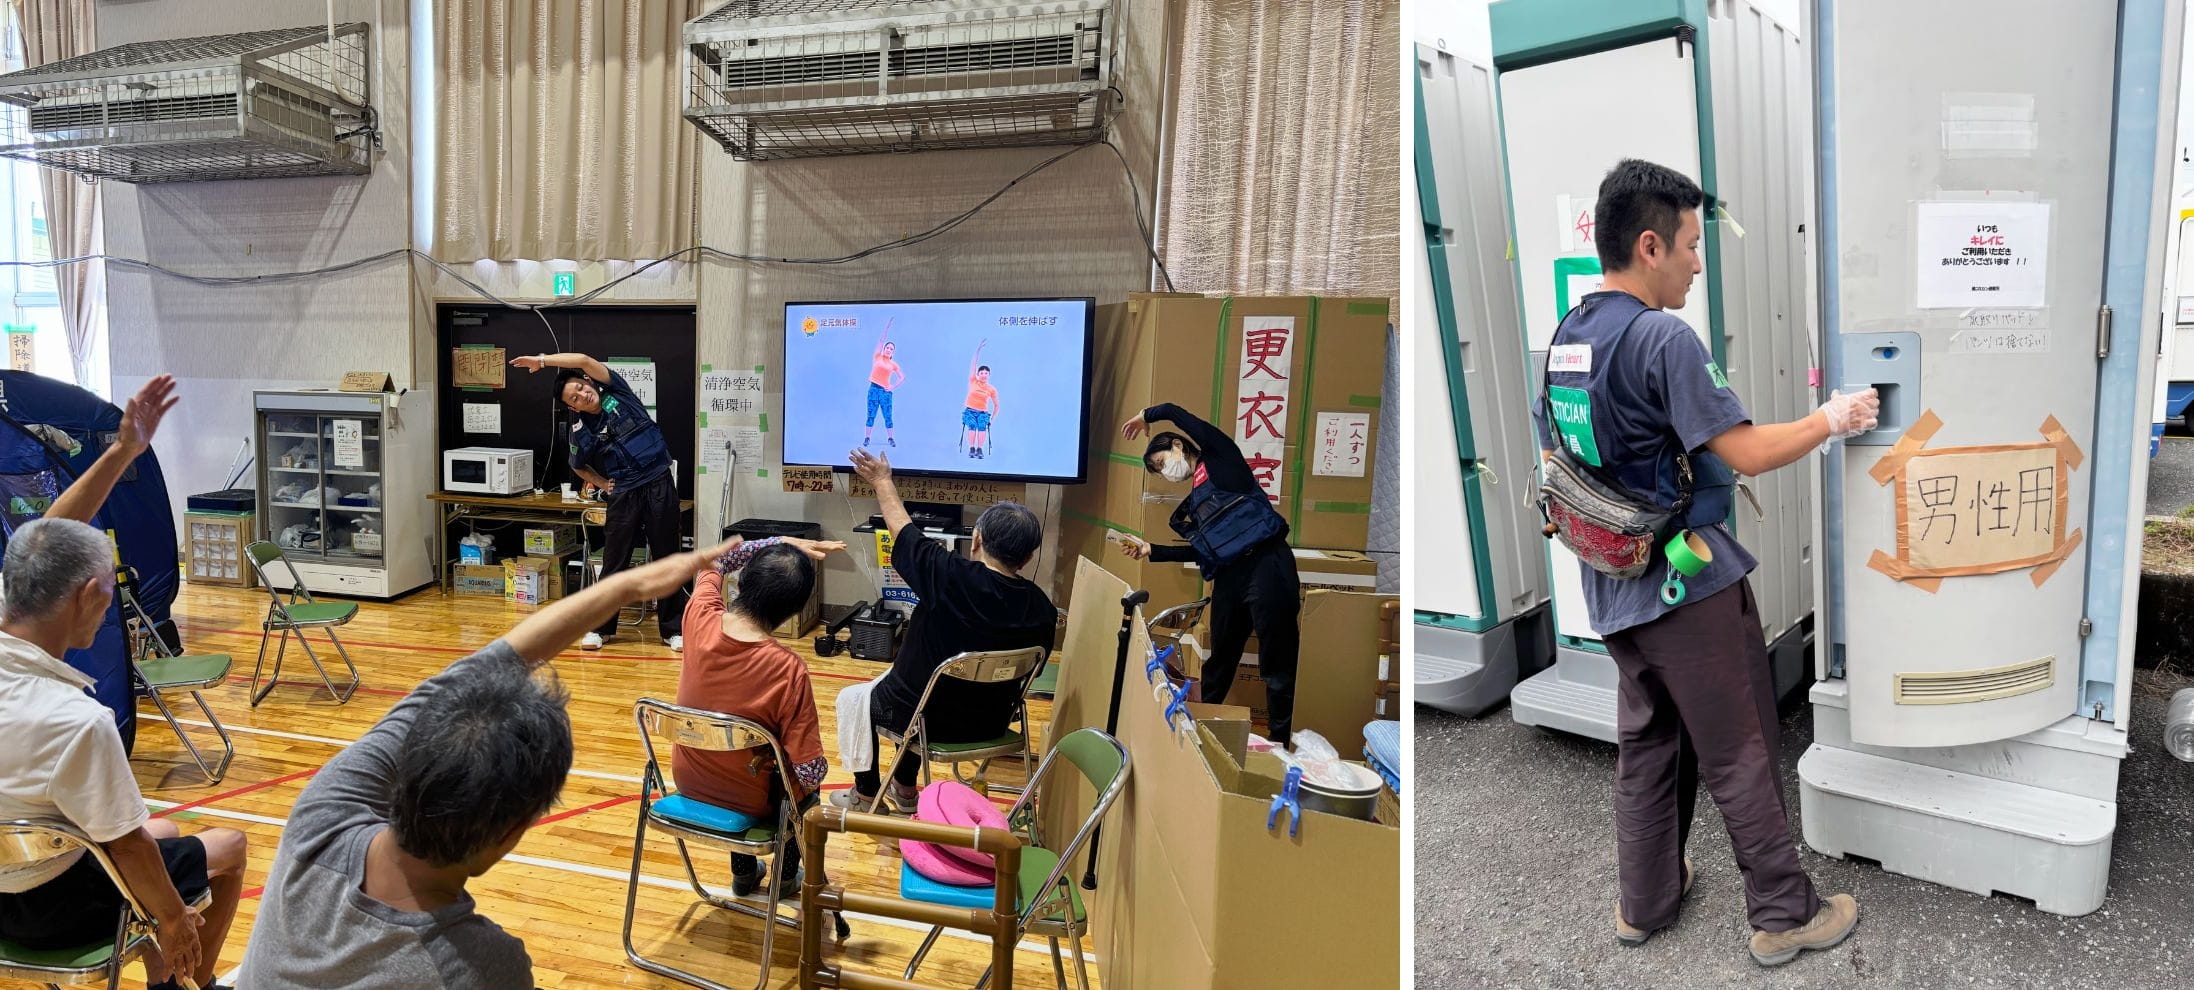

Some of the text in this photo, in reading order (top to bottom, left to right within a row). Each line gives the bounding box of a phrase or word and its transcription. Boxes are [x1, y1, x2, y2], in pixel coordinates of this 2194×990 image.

[1977, 225, 1998, 233] いつも
[1970, 236, 2004, 246] キレイに
[1961, 247, 2011, 256] ご利用いただき
[1941, 258, 2010, 266] ありがとうございます
[998, 315, 1058, 326] 体側を伸ばす
[705, 376, 760, 391] 清浄空気
[711, 397, 753, 412] 循環中
[1348, 422, 1365, 465] 一人ずつ
[783, 469, 832, 480] テレビ使用時間
[1918, 466, 2055, 545] 男性用
